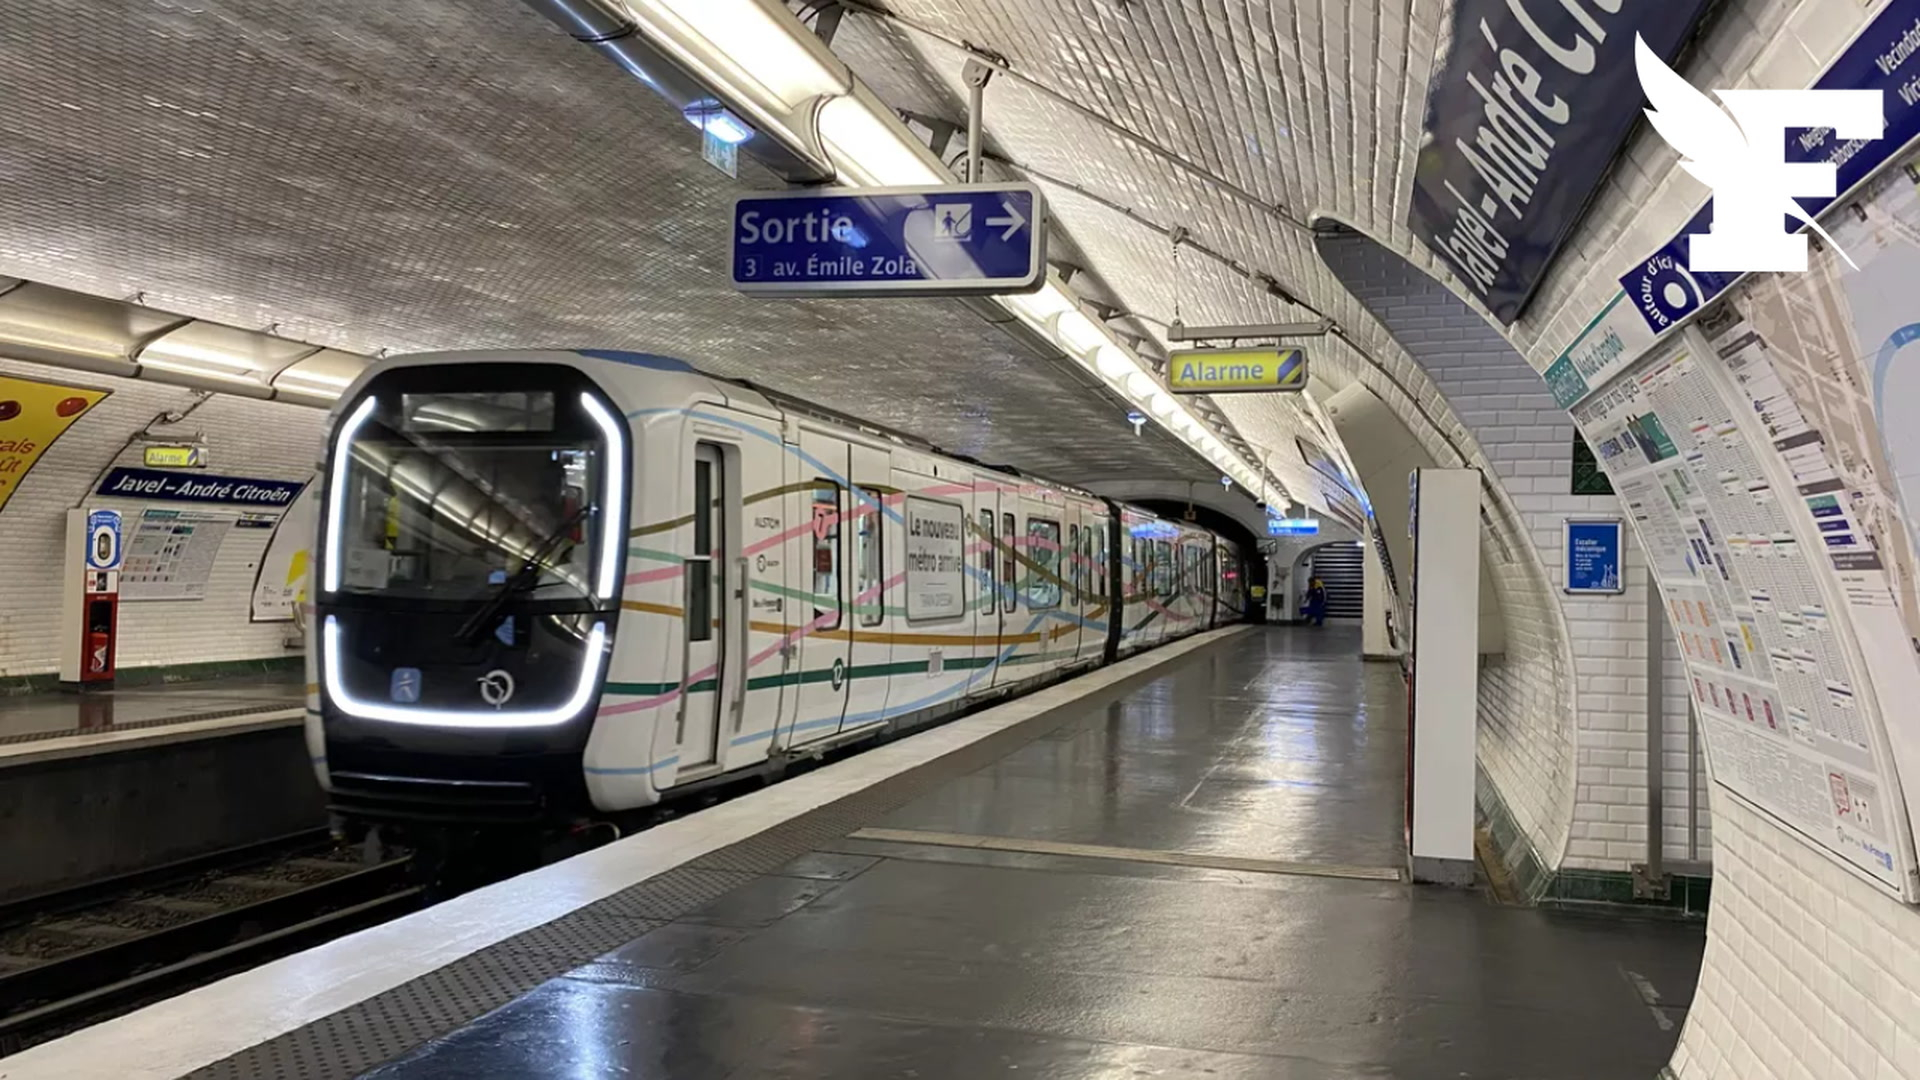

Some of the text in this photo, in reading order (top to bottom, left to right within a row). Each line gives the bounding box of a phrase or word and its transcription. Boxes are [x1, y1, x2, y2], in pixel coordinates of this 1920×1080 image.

[739, 207, 854, 244] Sortie
[744, 253, 917, 277] 3 av. Émile Zola
[1641, 275, 1669, 327] autour
[1180, 361, 1264, 382] Alarme
[150, 452, 183, 463] Alarme
[232, 485, 291, 502] Citroën
[909, 510, 960, 541] Le nouveau
[908, 545, 937, 573] métro
[833, 663, 843, 685] 12
